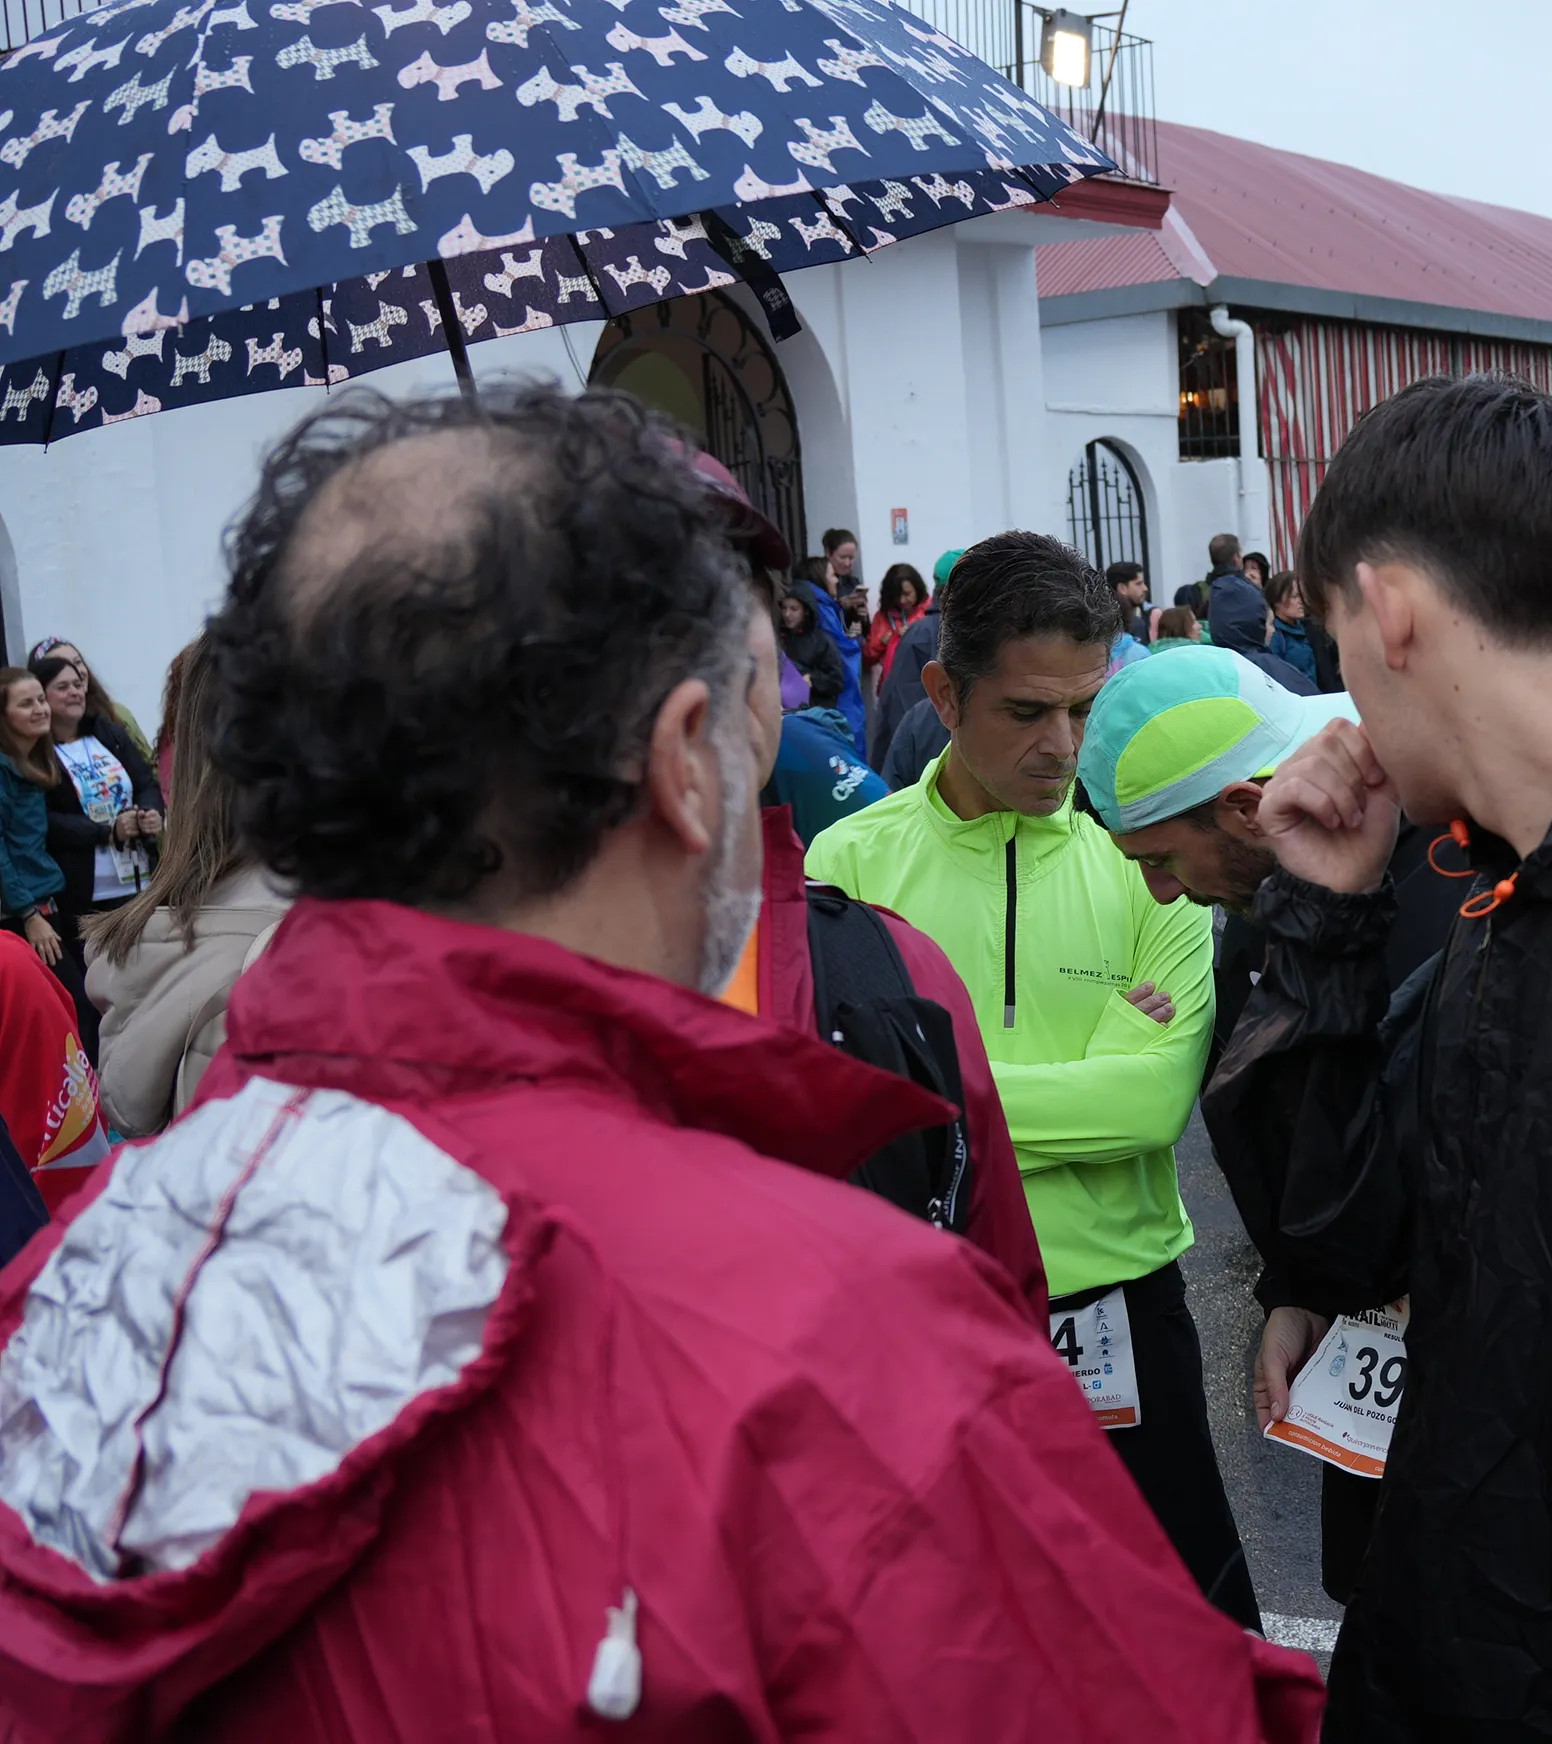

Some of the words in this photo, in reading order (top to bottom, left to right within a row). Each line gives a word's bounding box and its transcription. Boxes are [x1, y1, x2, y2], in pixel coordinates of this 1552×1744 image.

[1059, 967, 1102, 978] BELMEZ
[1333, 1400, 1353, 1412] JUAN
[1353, 1406, 1365, 1416] DEL
[1366, 1409, 1386, 1422] POZO
